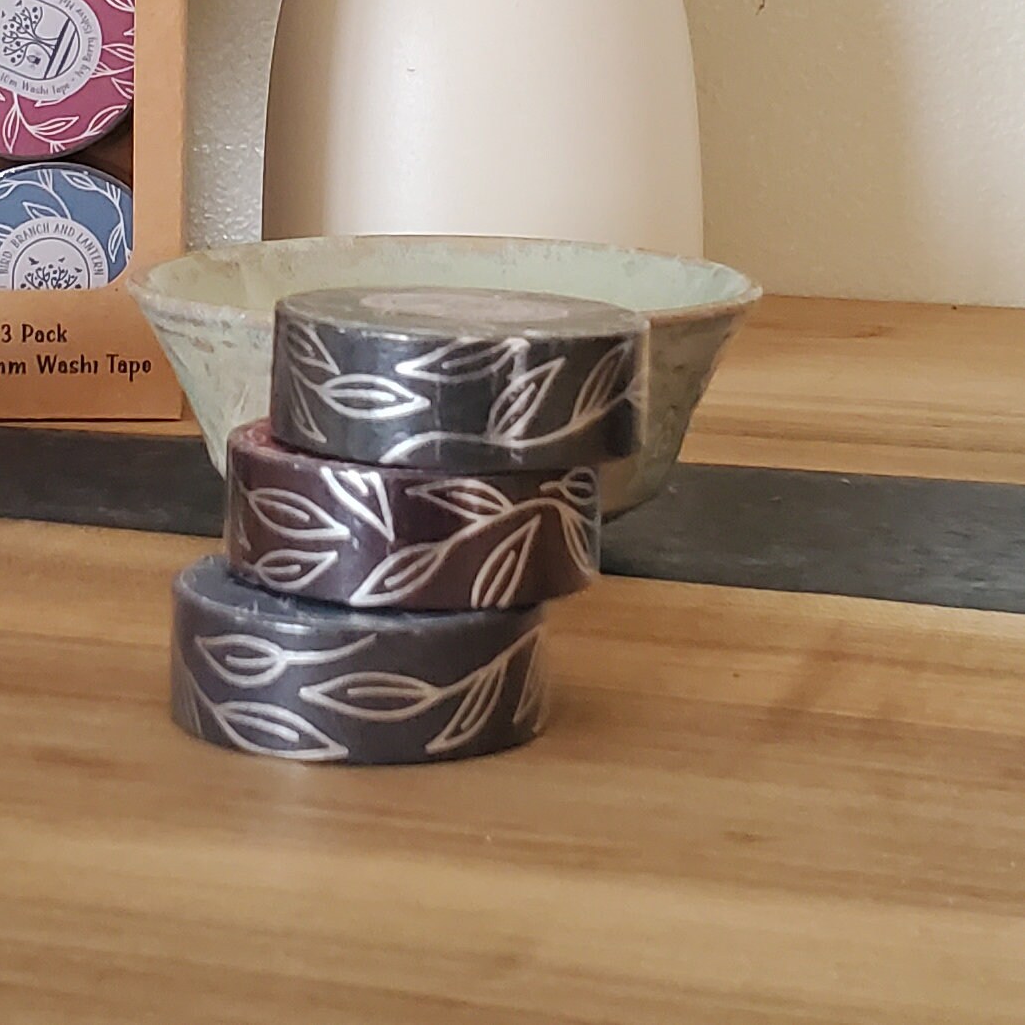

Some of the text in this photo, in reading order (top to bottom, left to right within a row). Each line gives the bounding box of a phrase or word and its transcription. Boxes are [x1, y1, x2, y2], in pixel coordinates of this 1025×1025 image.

[22, 80, 49, 95] Washi
[10, 222, 50, 249] BRANCH
[53, 223, 75, 237] AND
[75, 232, 104, 276] LANTERN
[1, 323, 67, 343] 3 Pack
[36, 354, 99, 374] Washi
[106, 354, 152, 382] Tape
